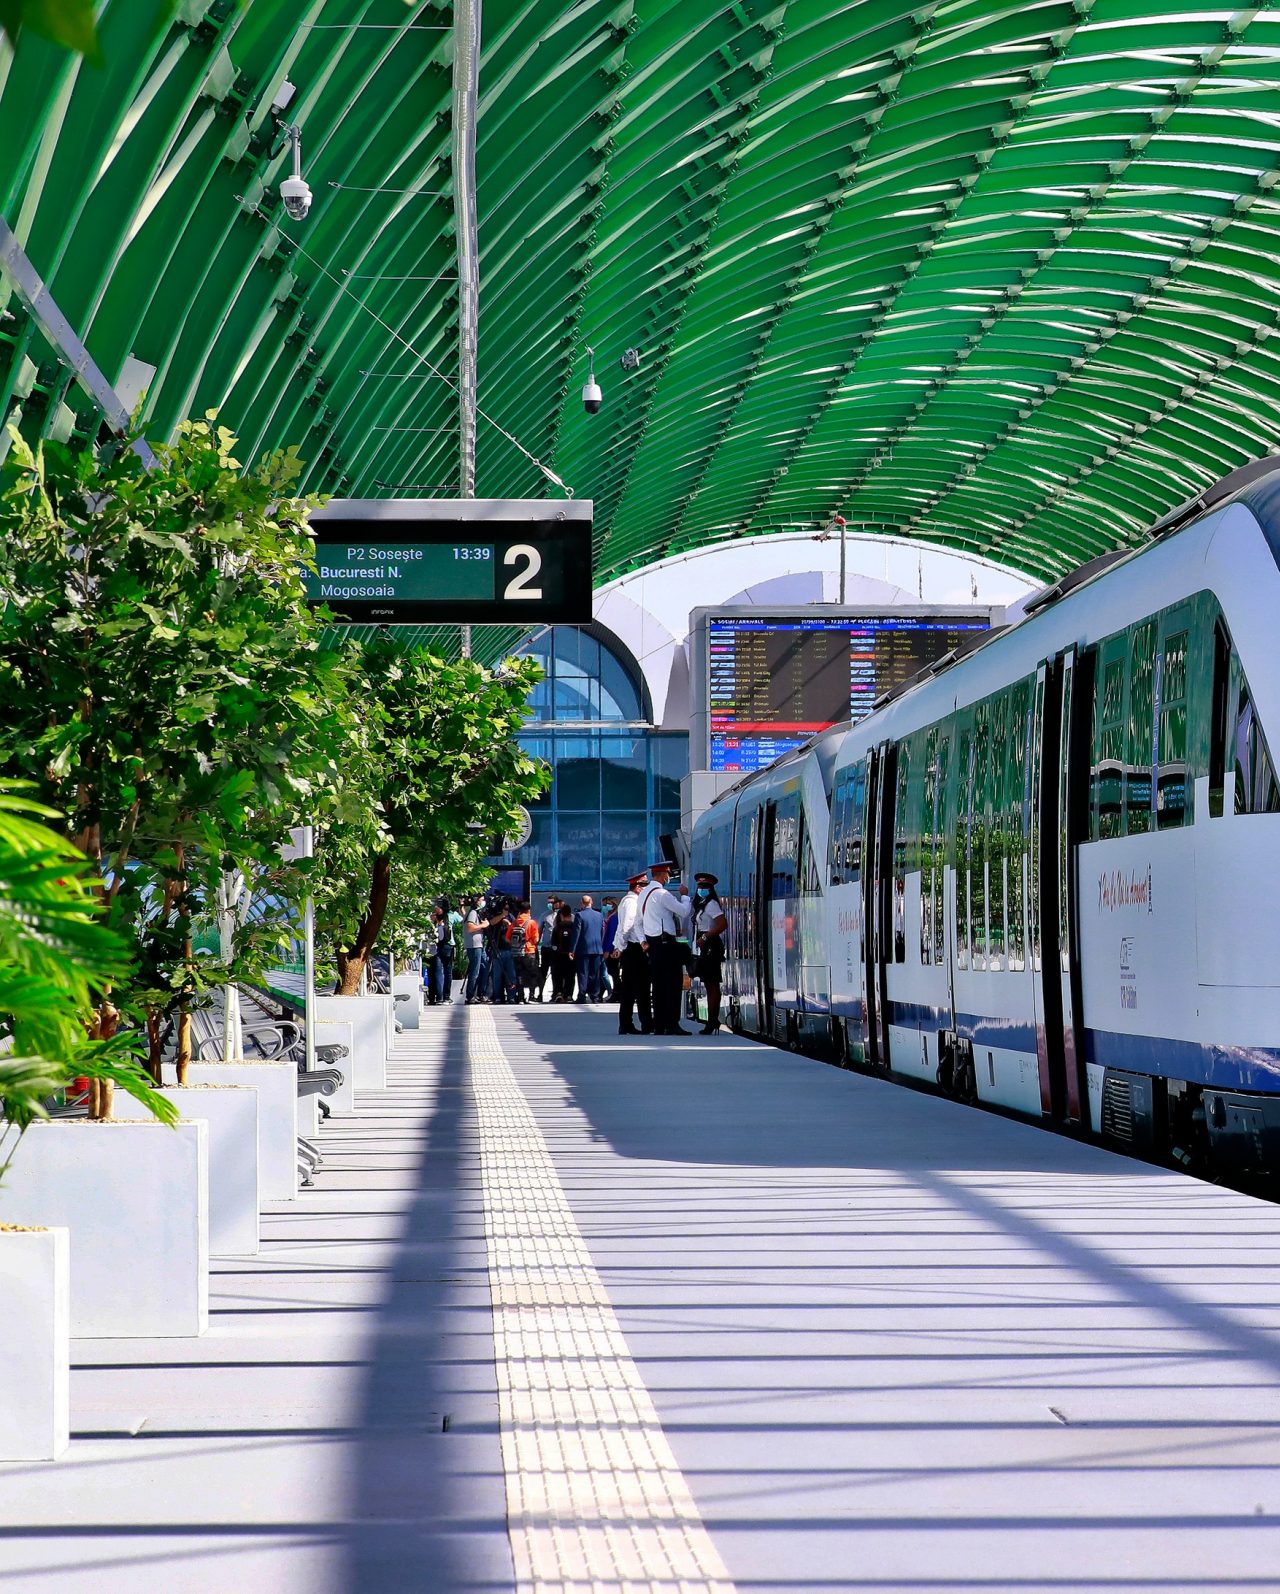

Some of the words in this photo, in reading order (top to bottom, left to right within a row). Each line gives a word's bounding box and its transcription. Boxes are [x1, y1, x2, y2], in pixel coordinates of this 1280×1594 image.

[347, 547, 365, 560] P2
[452, 548, 490, 560] 13:39
[320, 566, 384, 578] Bucuresti
[388, 566, 402, 578] N.
[503, 543, 543, 600] 2
[321, 583, 395, 599] Mogosoaia
